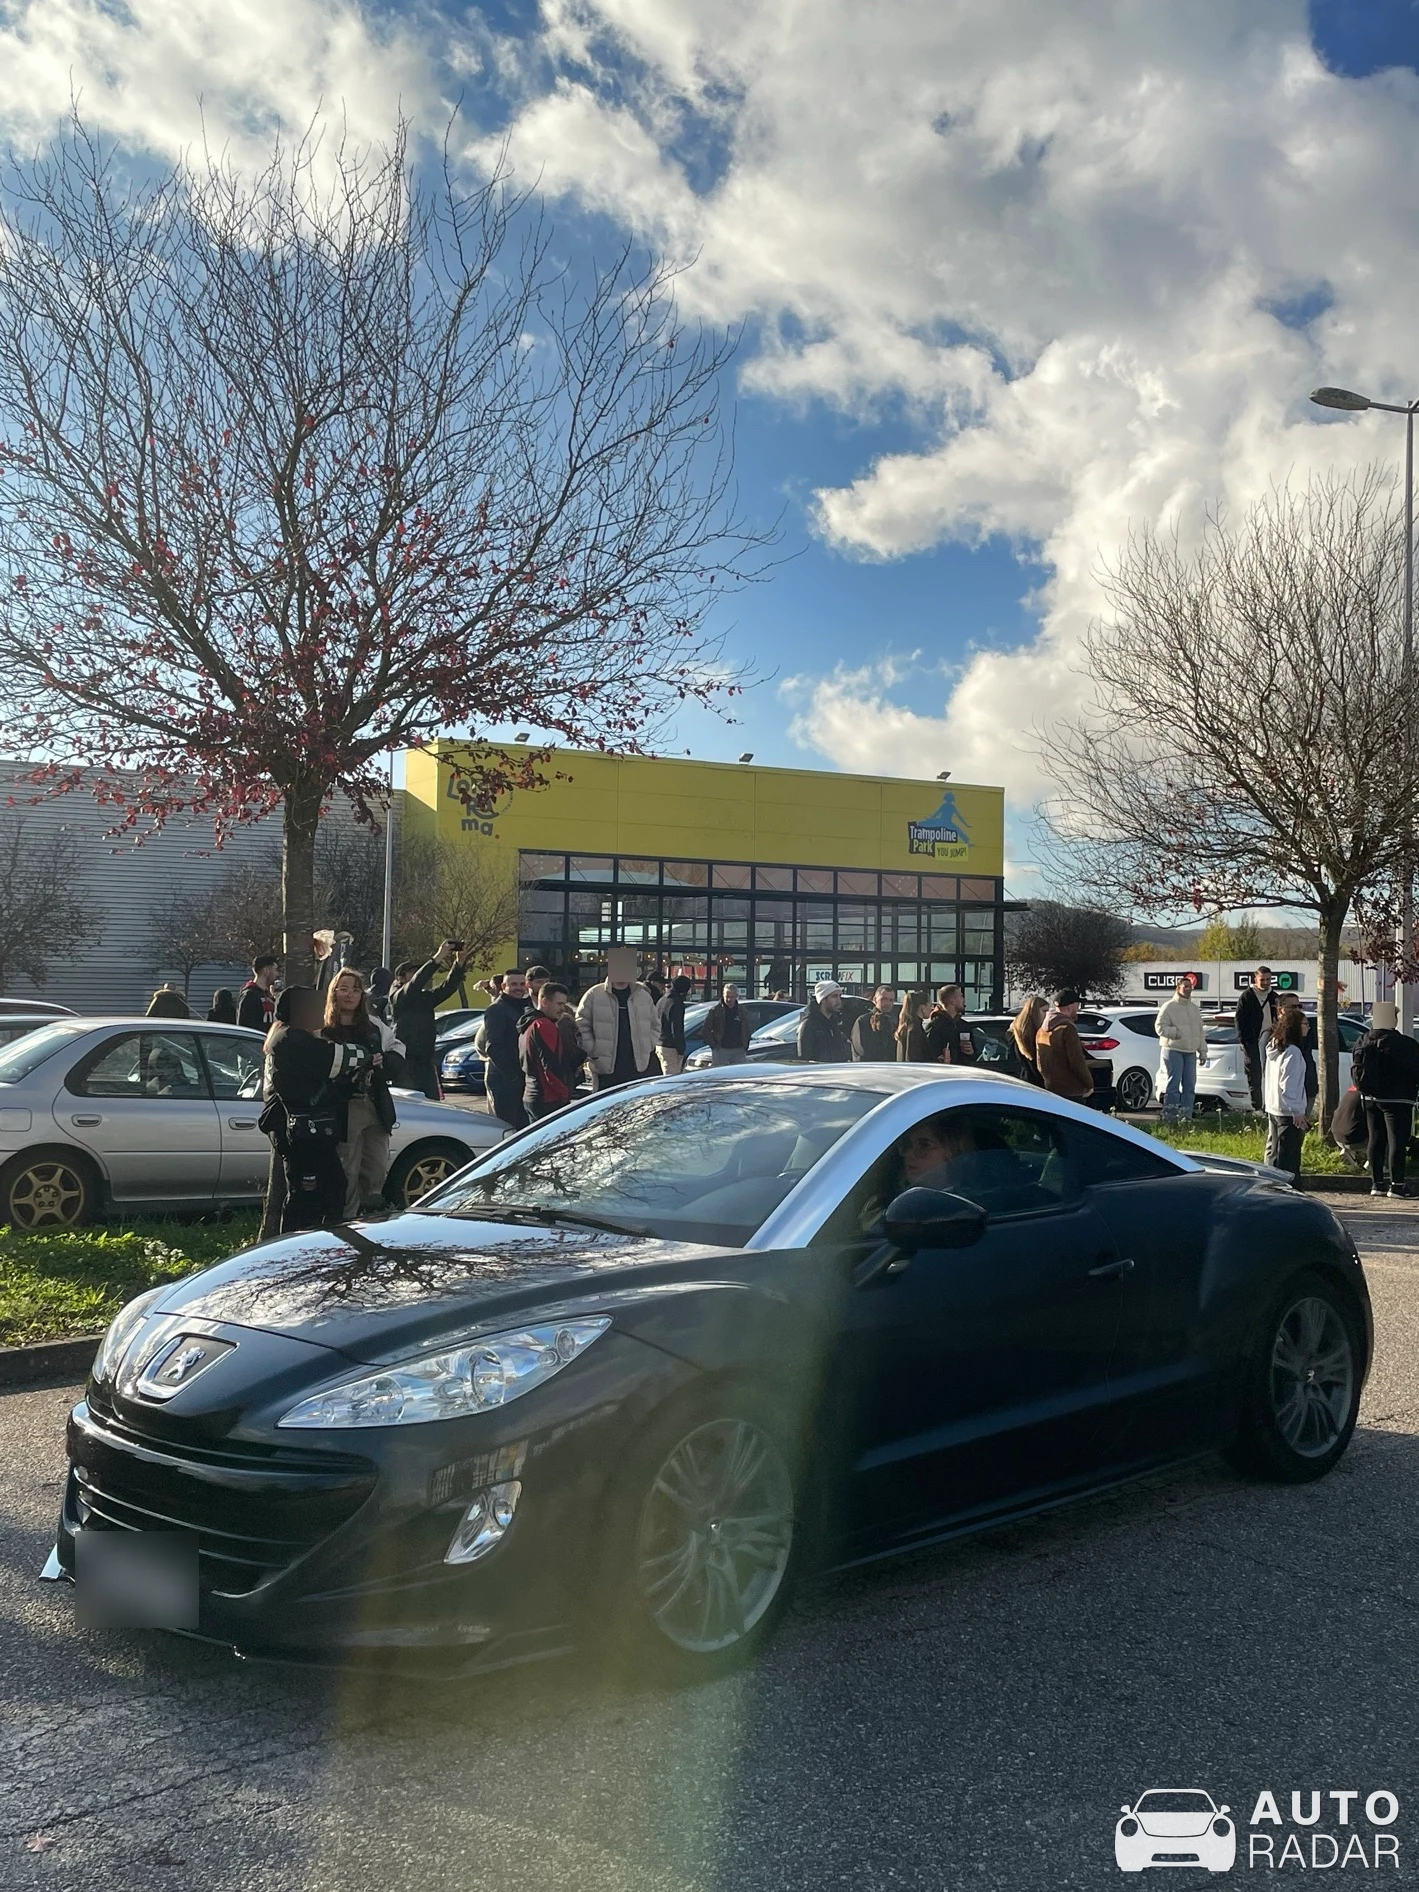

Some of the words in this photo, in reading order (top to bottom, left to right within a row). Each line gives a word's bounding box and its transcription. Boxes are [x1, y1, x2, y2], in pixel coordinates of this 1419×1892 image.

[909, 825, 957, 843] Trampoline
[913, 838, 933, 853] Park
[937, 847, 949, 857] YOU
[815, 971, 855, 981] SCRFIX
